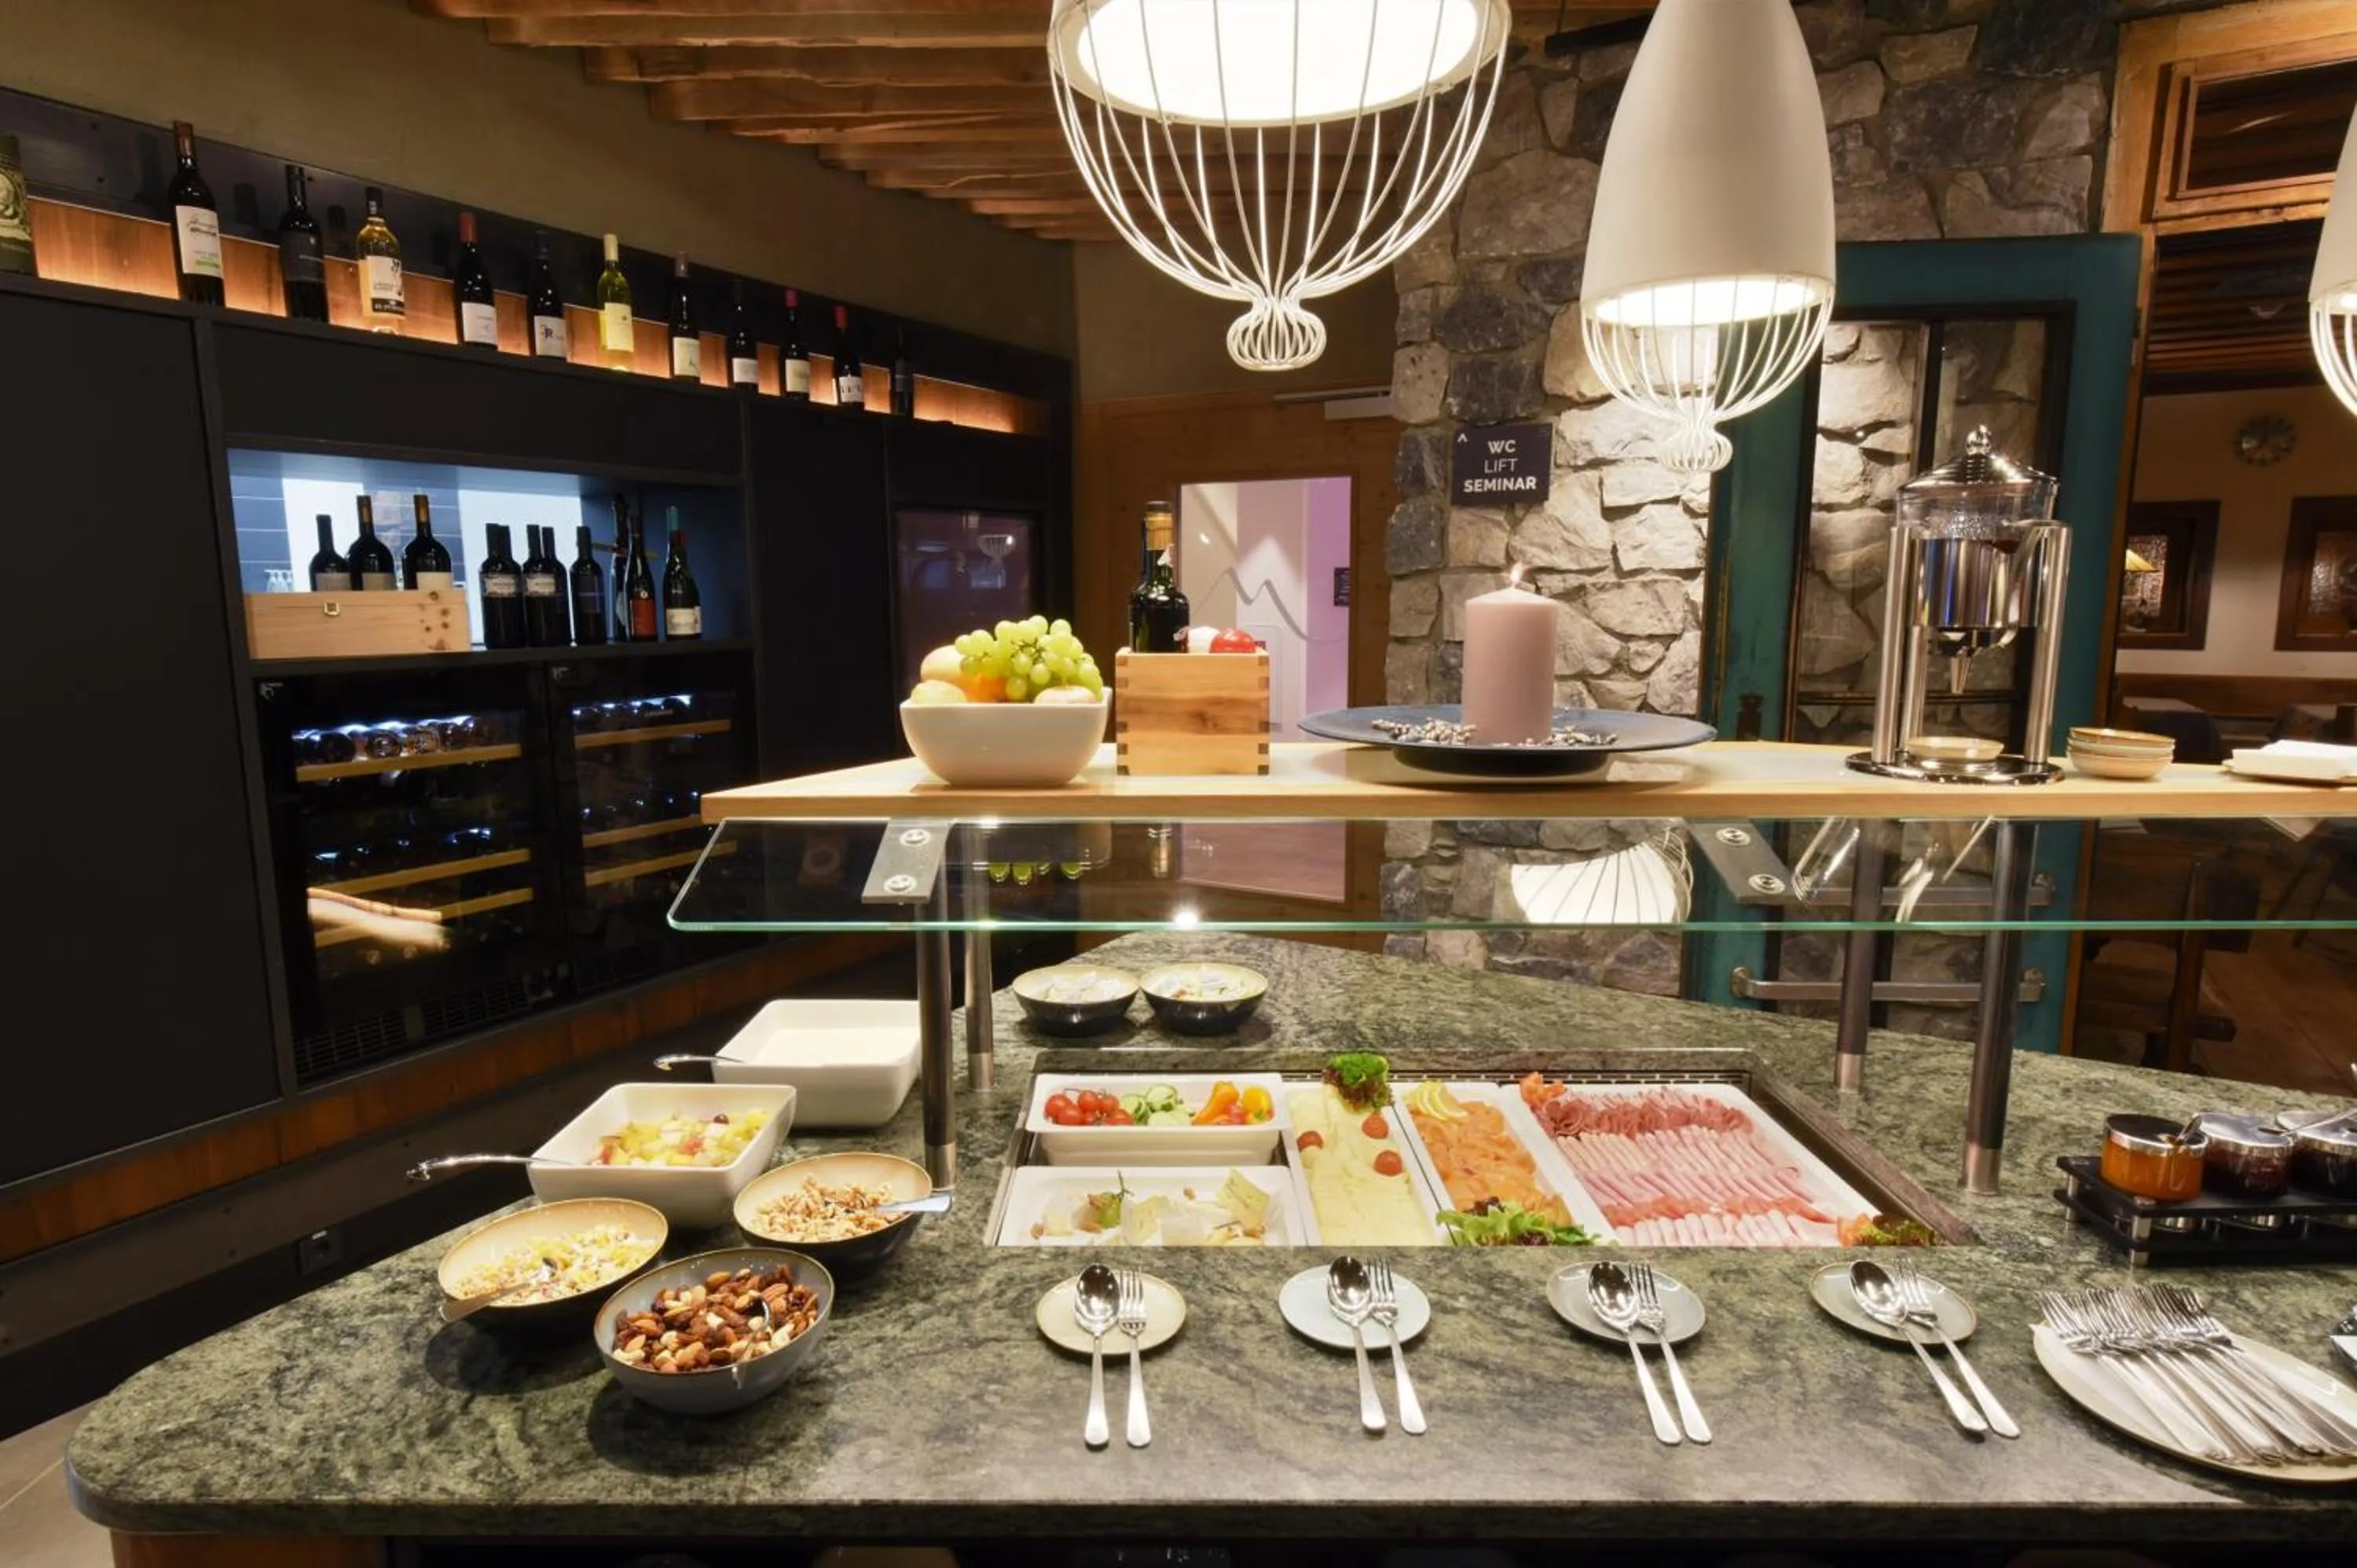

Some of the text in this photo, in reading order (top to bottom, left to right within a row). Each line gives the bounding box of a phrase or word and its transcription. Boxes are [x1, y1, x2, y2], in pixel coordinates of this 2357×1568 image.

[1488, 440, 1516, 453] WC
[1484, 459, 1518, 473] LIFT
[1464, 477, 1536, 492] SEMINAR
